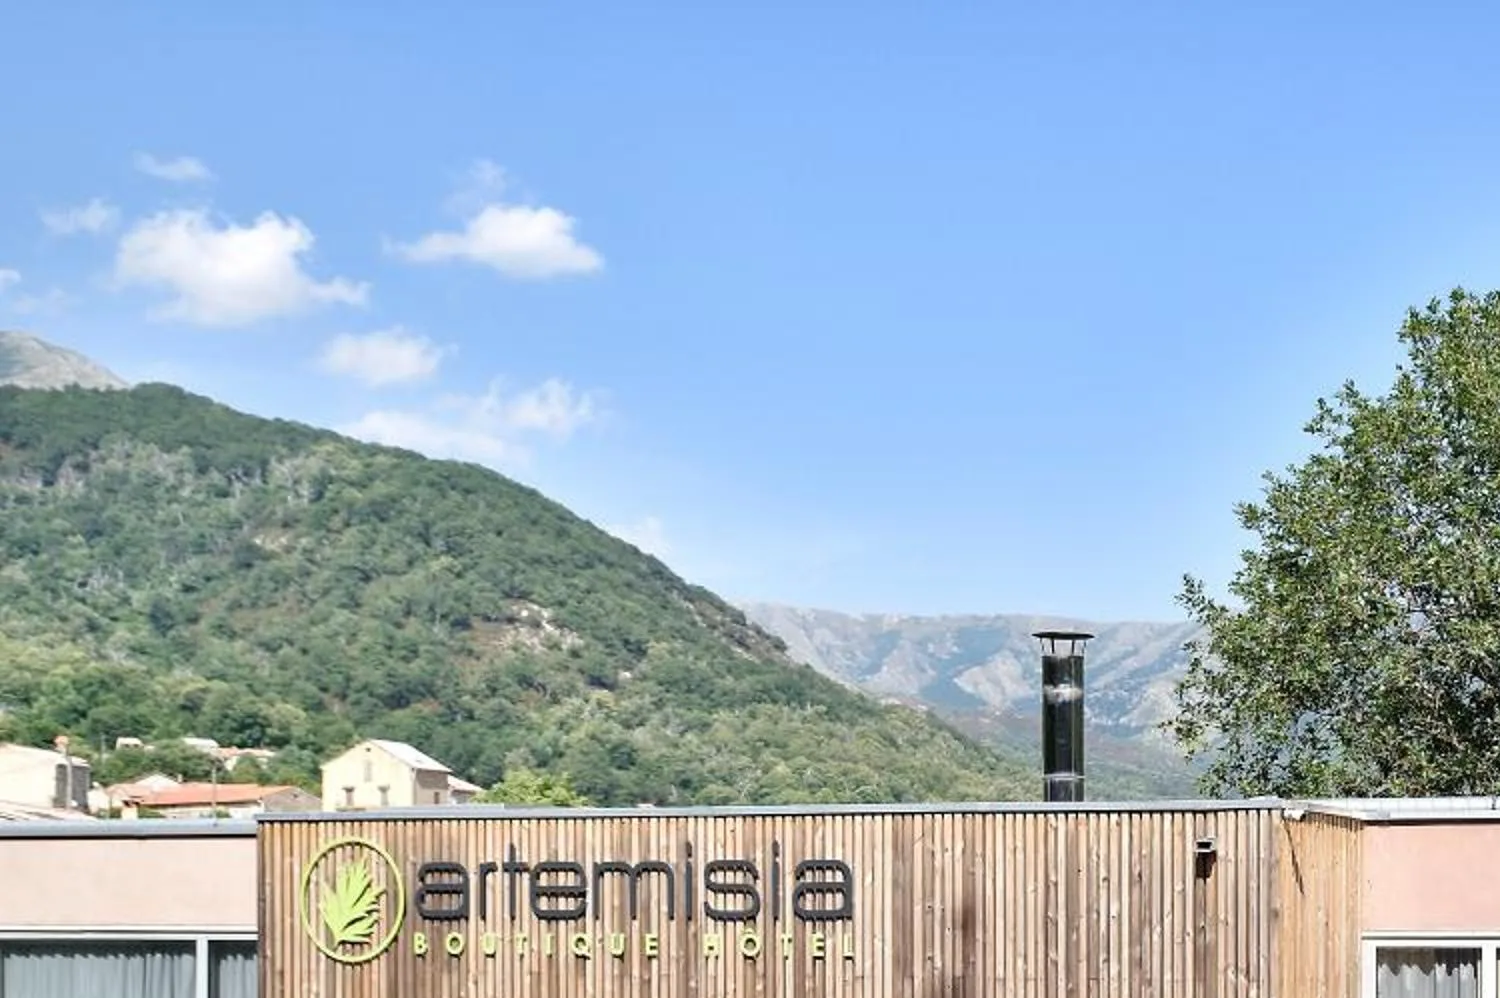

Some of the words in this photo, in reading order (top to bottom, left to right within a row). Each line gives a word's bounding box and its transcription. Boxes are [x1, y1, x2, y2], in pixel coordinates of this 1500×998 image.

[415, 841, 853, 920] artemisia
[413, 932, 659, 957] BOUTIQUE
[703, 928, 854, 959] HÔTEL
